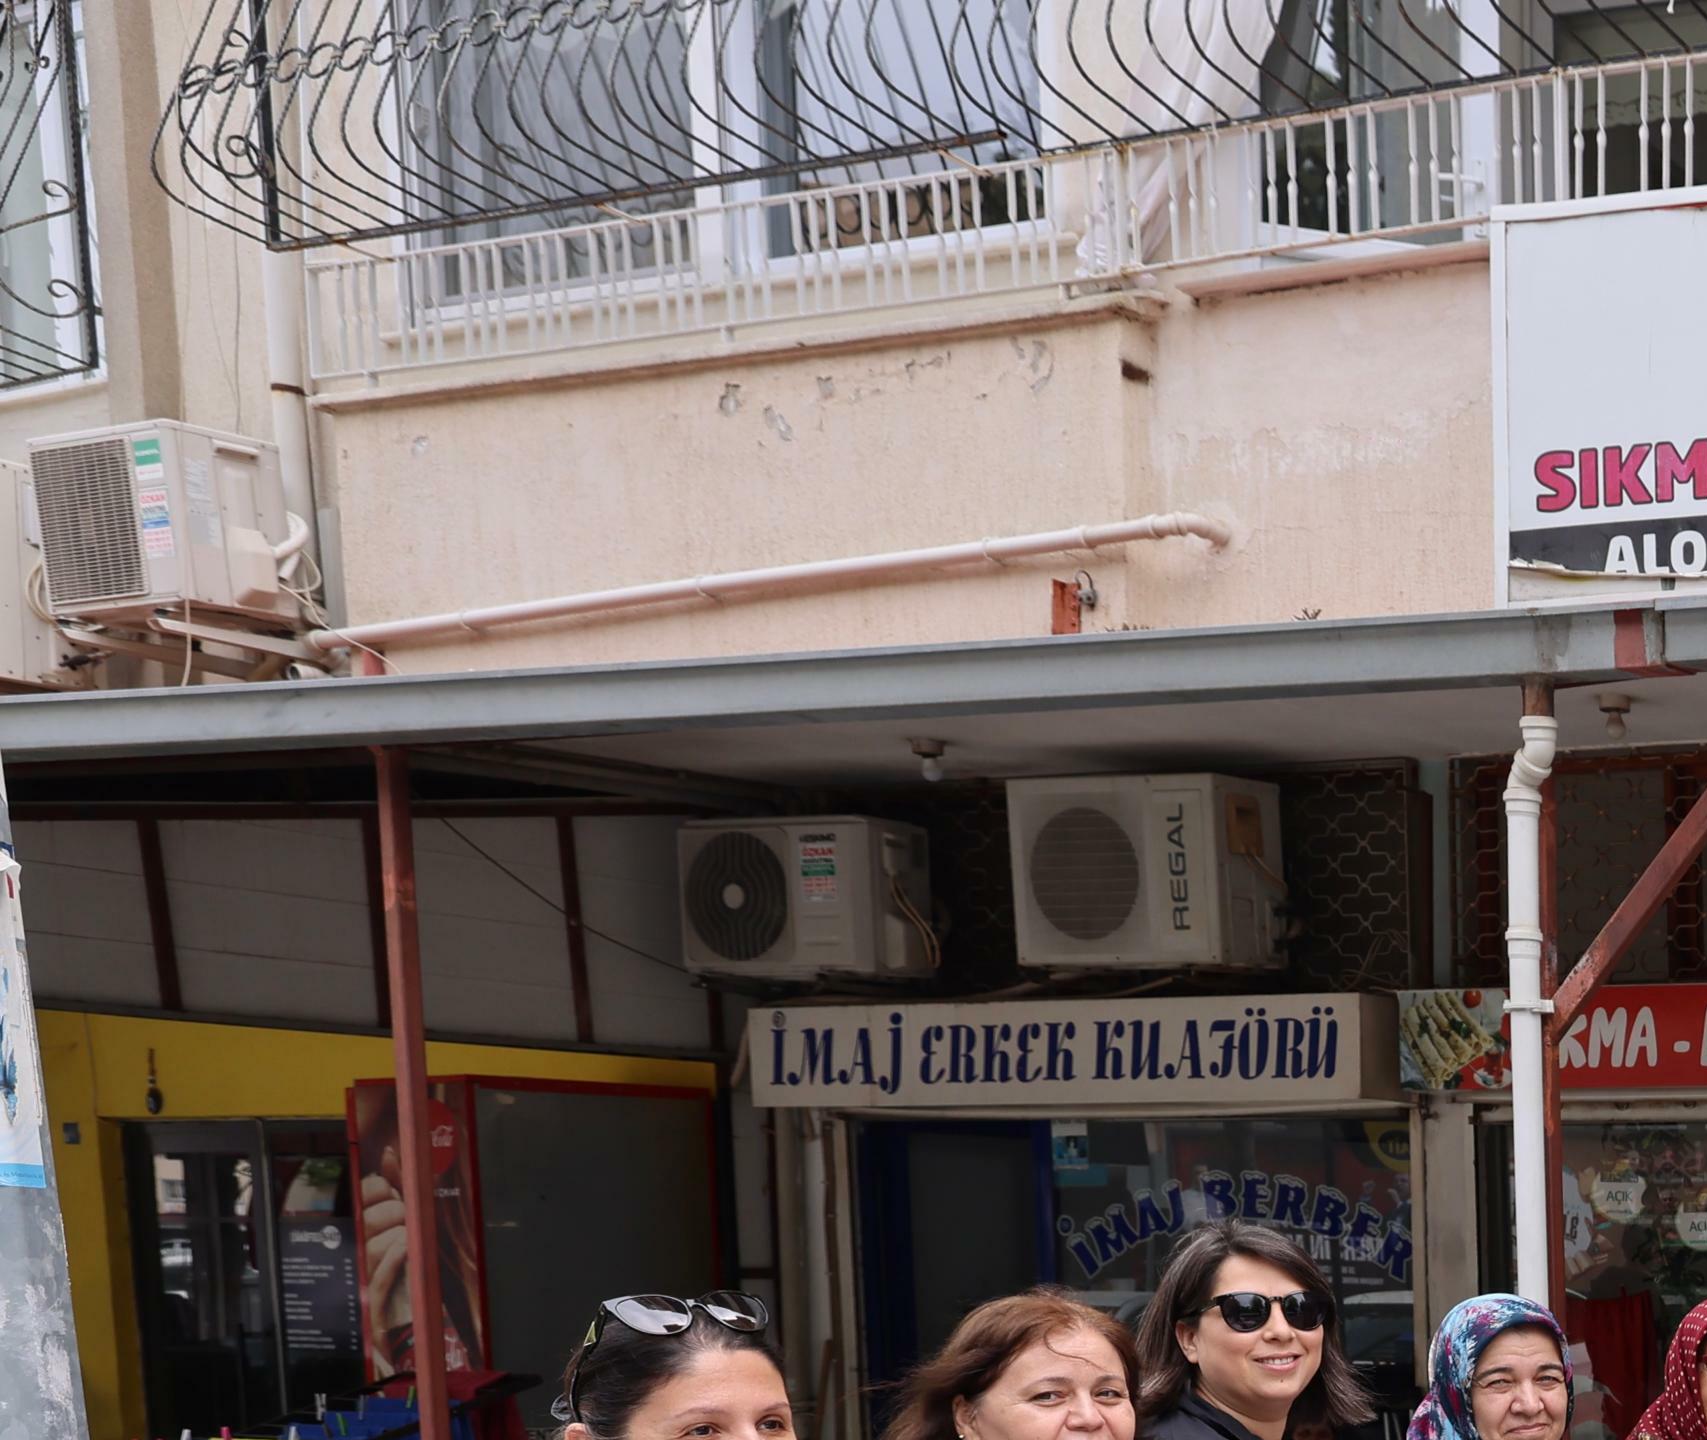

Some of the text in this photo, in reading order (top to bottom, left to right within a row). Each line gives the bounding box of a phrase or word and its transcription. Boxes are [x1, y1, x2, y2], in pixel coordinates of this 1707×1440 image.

[1602, 530, 1707, 577] ALO
[1166, 803, 1191, 930] REGAL
[919, 1021, 1077, 1085] ERKEK
[1092, 1006, 1339, 1081] KUAFÖRÜ
[1558, 1005, 1658, 1069] KMA
[1057, 1169, 1414, 1283] İMAJ BERBER
[1606, 1190, 1633, 1205] AÇIK
